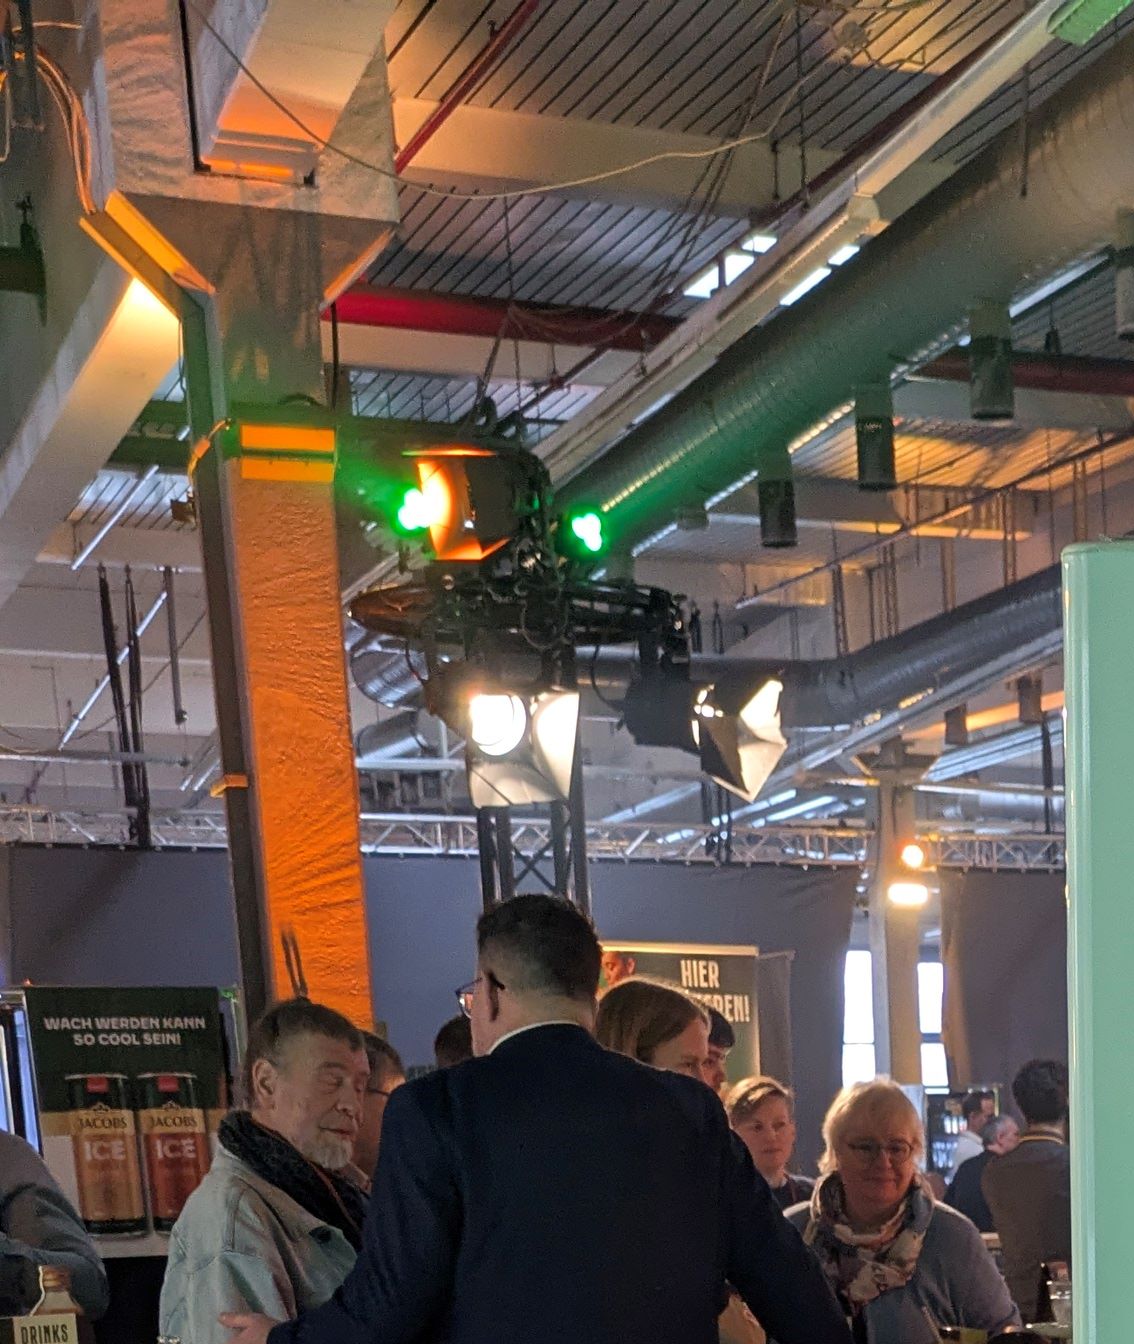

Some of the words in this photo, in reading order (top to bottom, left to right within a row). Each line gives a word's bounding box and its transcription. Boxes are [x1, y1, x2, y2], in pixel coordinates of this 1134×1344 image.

[680, 959, 720, 988] HIER
[44, 1018, 92, 1030] WACH
[95, 1017, 160, 1030] WERDEN
[163, 1017, 206, 1030] KANN
[73, 1034, 95, 1046] SO
[99, 1034, 141, 1046] COOL
[143, 1033, 181, 1045] SEIN!
[79, 1116, 128, 1129] JACOBS
[150, 1115, 198, 1128] JACOBS
[84, 1139, 126, 1161] ICE
[155, 1138, 197, 1159] ICE
